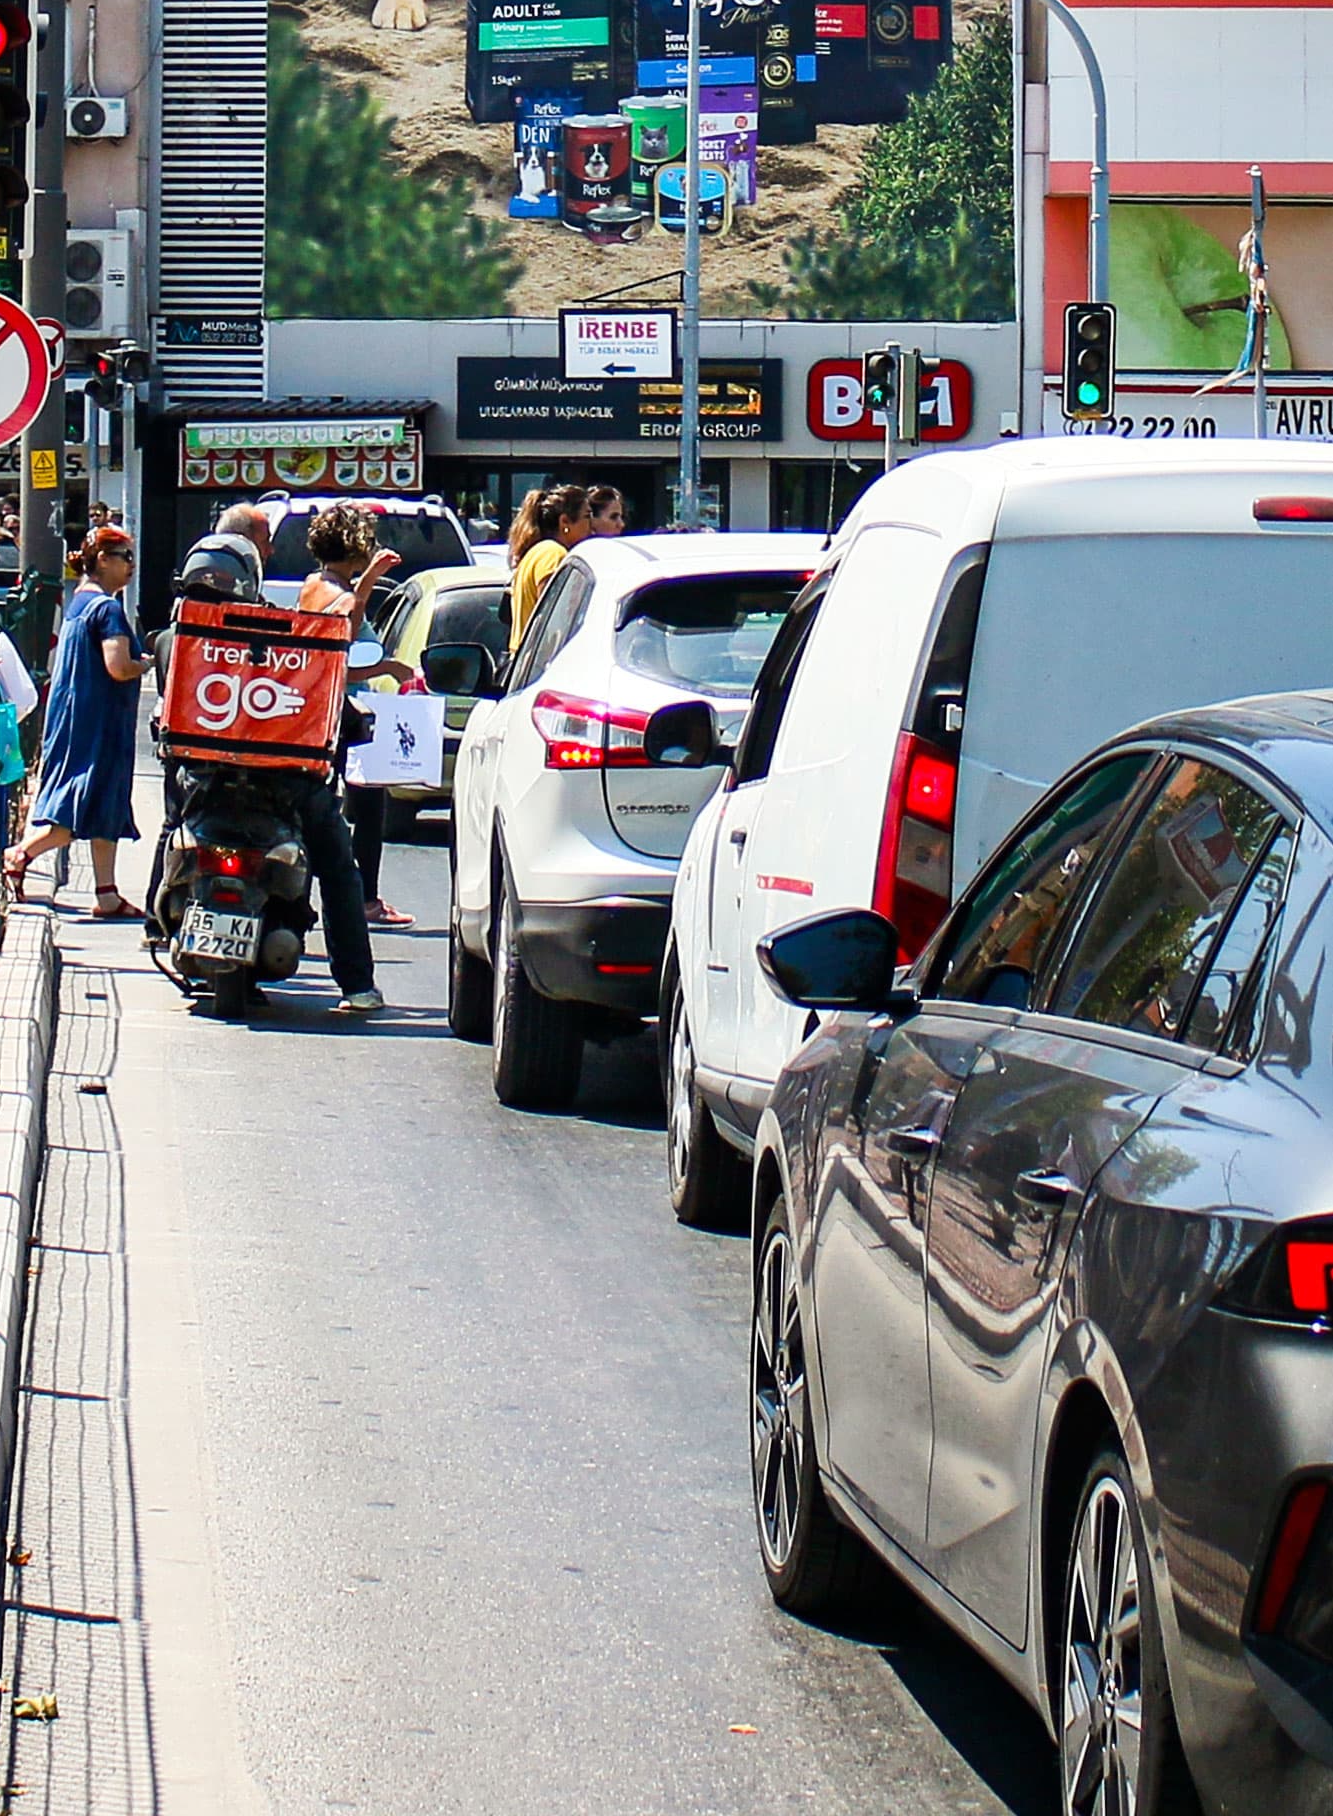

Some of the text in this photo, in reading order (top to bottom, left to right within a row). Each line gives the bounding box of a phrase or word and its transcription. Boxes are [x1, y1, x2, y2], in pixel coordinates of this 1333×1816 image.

[492, 4, 540, 18] ADULT
[578, 317, 659, 339] İRENBE
[703, 423, 762, 438] GROUP
[230, 918, 254, 938] KA
[197, 935, 247, 958] 2720
